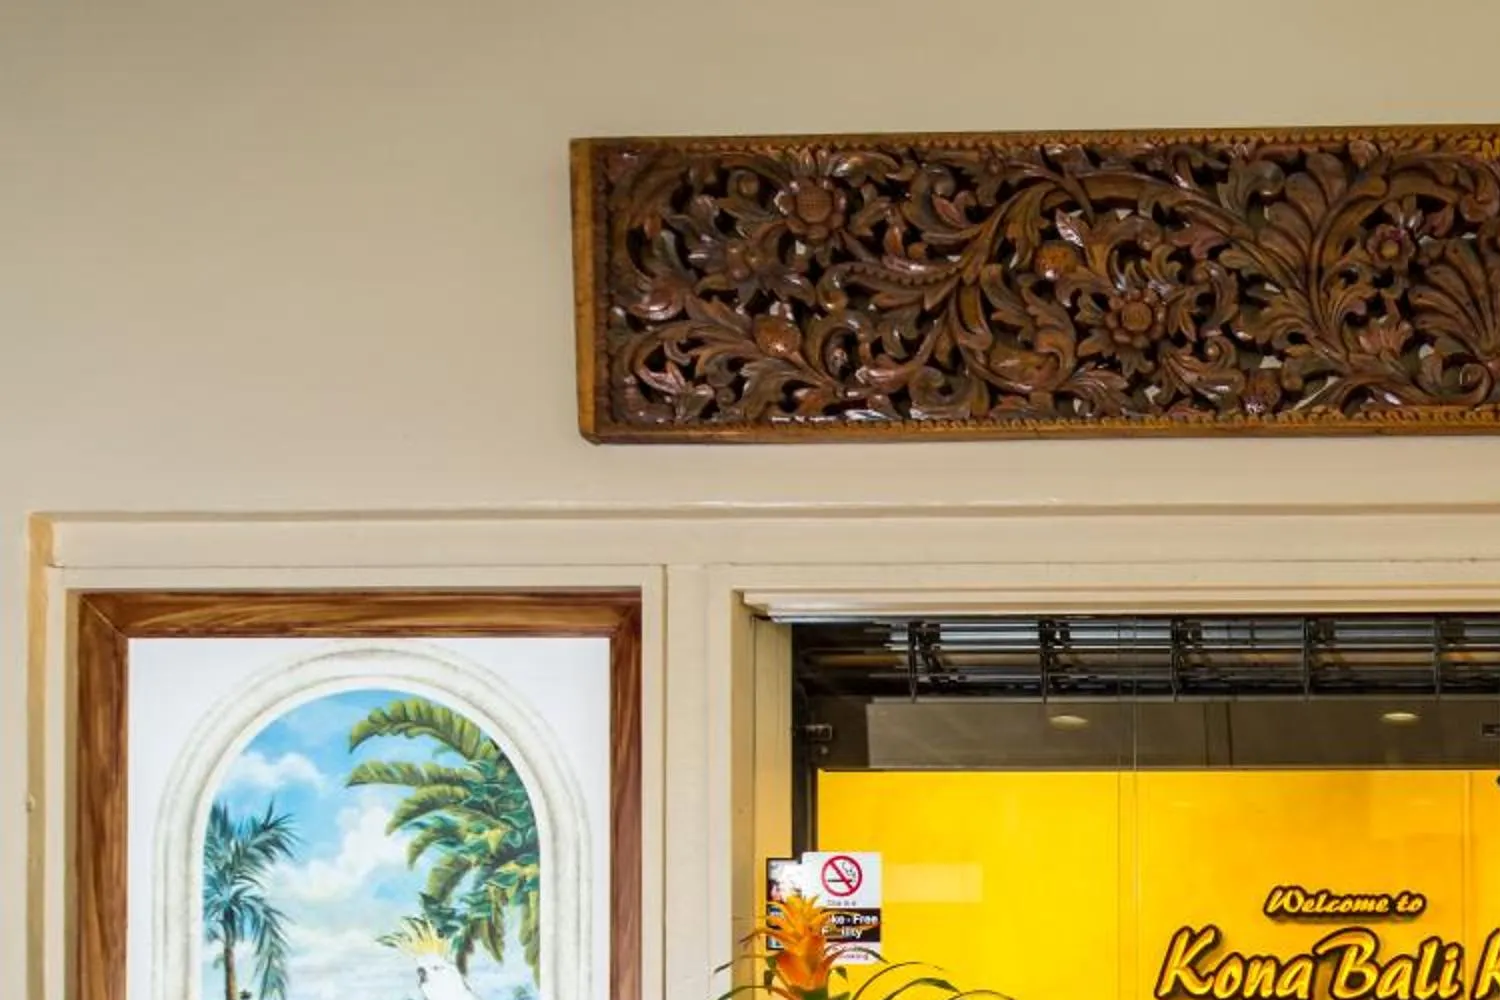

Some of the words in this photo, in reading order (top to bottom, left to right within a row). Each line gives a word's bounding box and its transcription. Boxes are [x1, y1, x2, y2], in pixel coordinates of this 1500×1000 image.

[1265, 886, 1390, 915] Welcome
[1395, 890, 1425, 914] to
[821, 926, 863, 939] Fility
